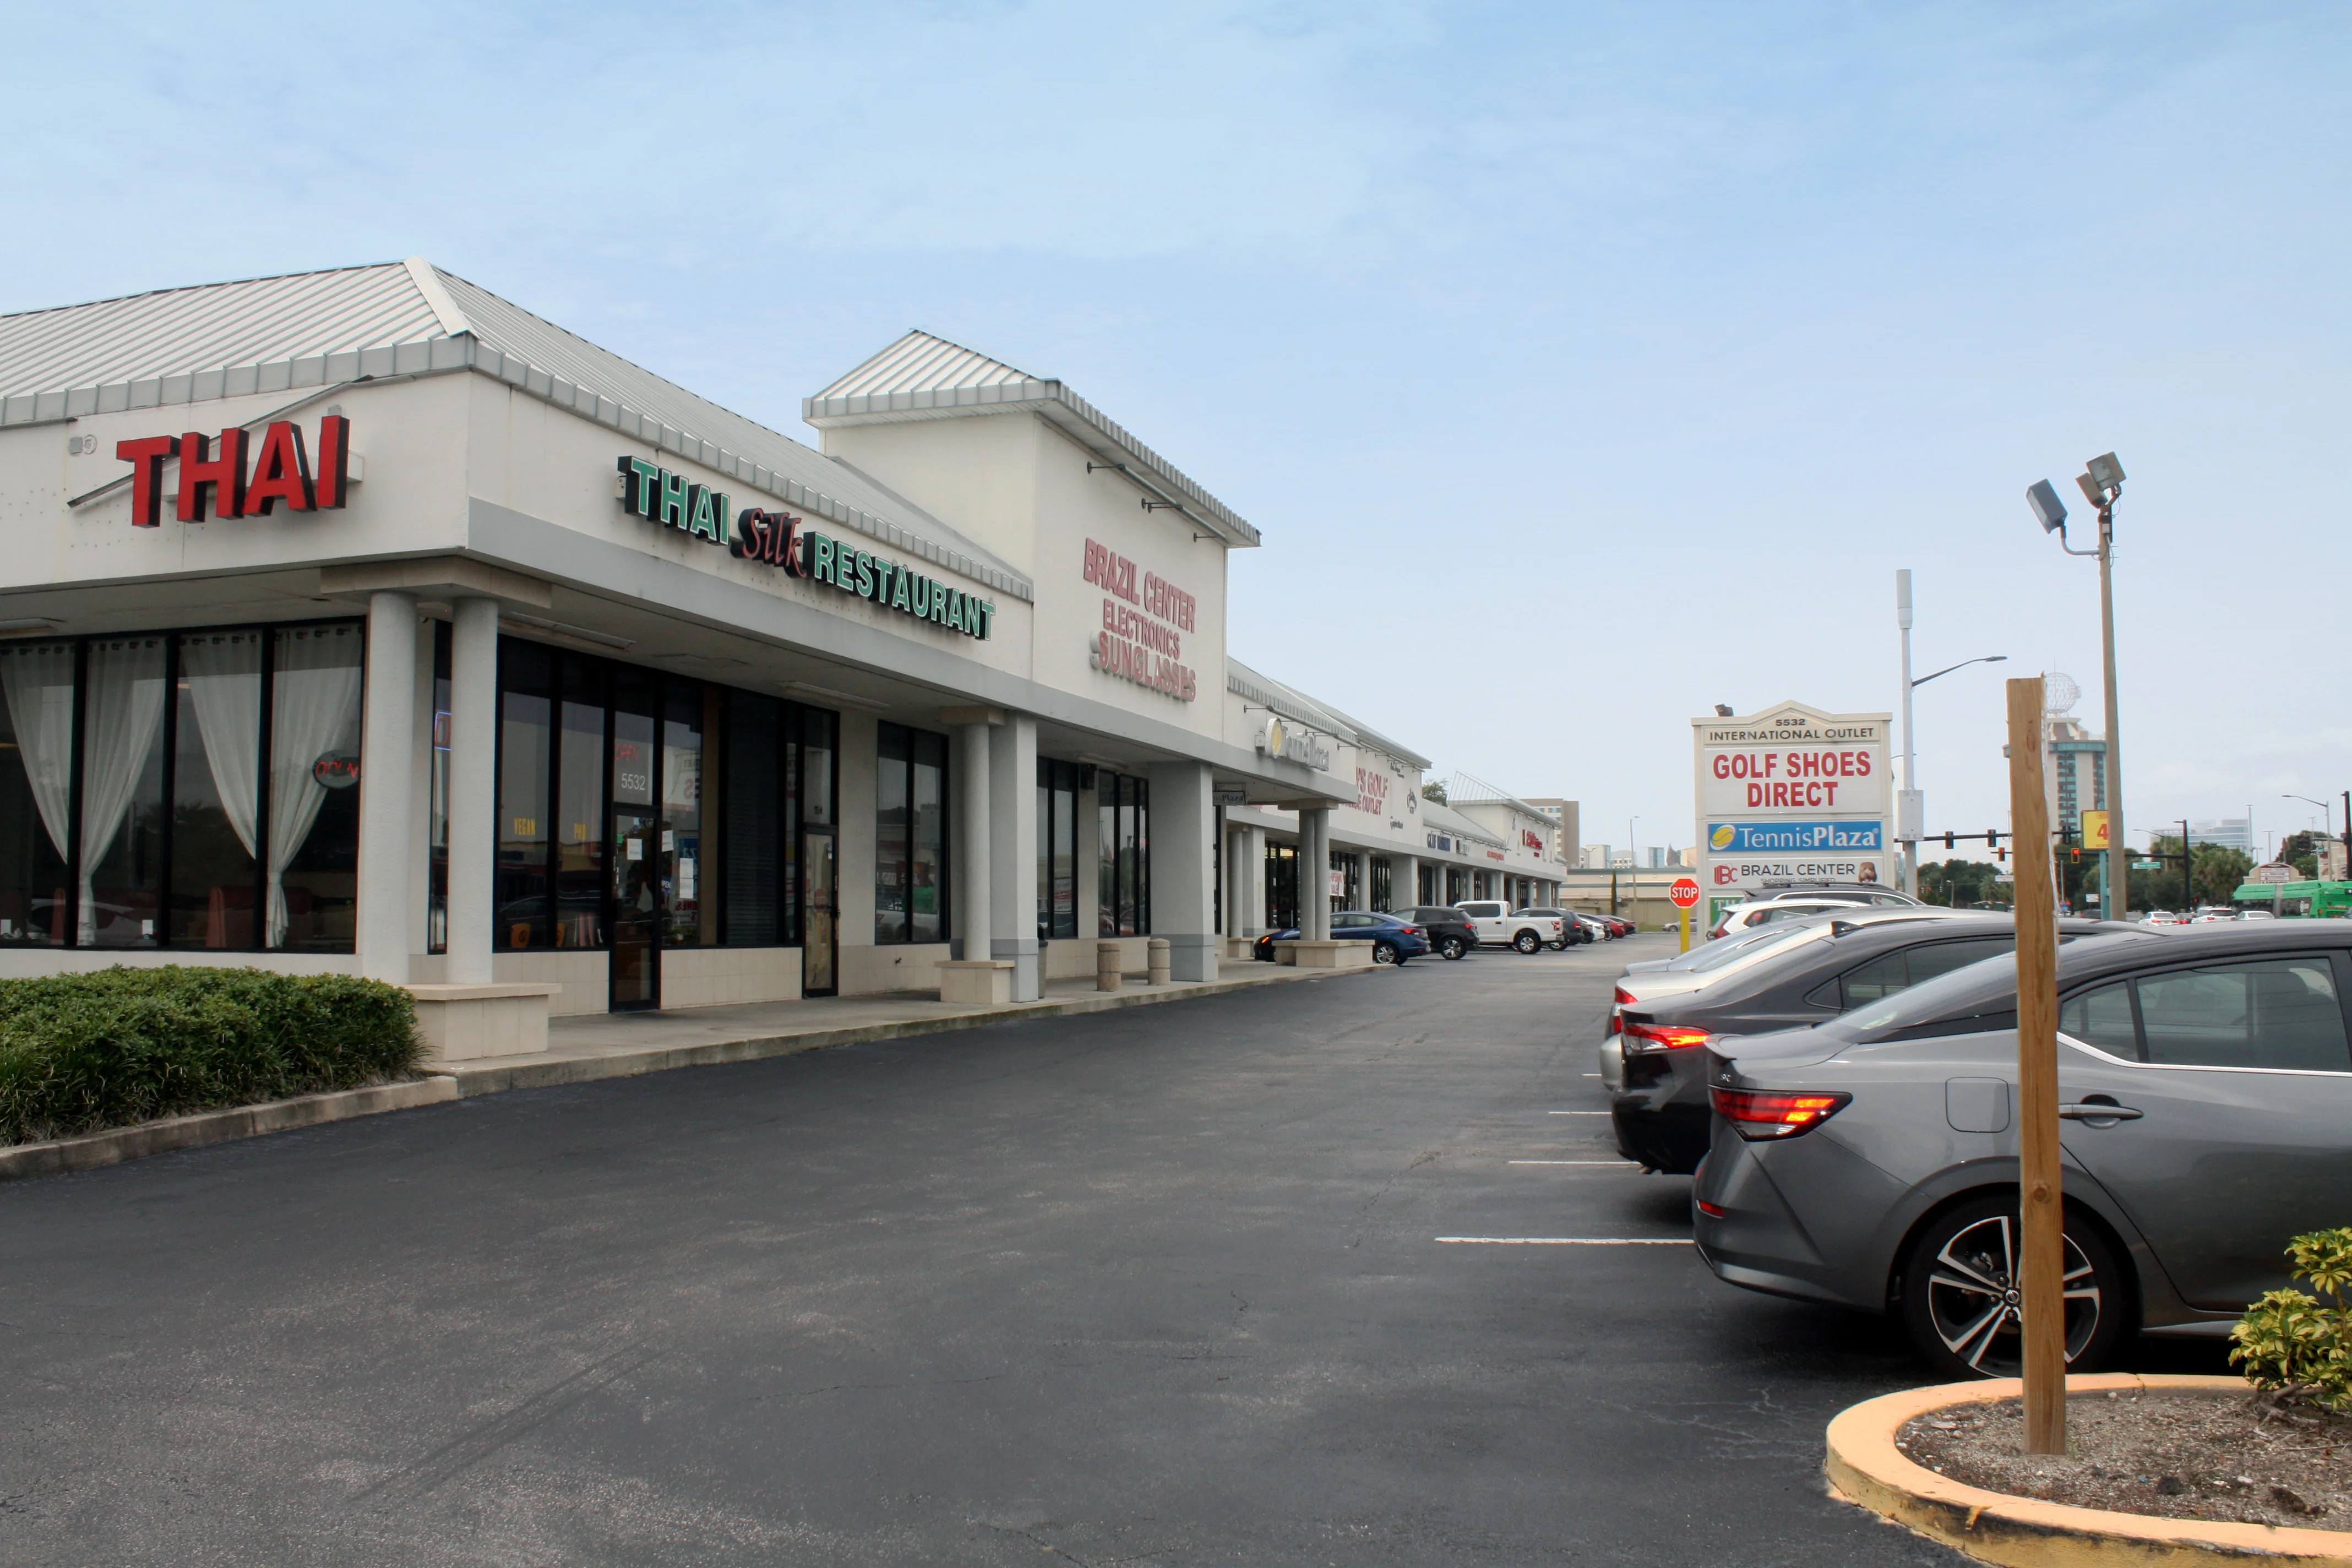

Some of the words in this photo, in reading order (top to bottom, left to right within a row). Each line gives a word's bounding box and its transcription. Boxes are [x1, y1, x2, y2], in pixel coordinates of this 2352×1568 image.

[116, 415, 350, 528] THAI
[627, 456, 730, 546] THAI
[741, 508, 807, 578] Silk
[812, 531, 996, 641] RESTAURANT
[1084, 537, 1140, 605] BRAZIL
[1144, 571, 1196, 633] CENTER
[1103, 598, 1180, 660] ELECTRONICS
[1096, 631, 1196, 702] SUNGLASSES
[1710, 729, 1820, 741] INTERNATIONAL
[1825, 728, 1874, 738] OUTLET
[1713, 753, 1777, 780] GOLF
[1787, 751, 1871, 777] SHOES
[621, 773, 645, 790] 5532
[1368, 771, 1388, 798] GOLF
[1363, 795, 1382, 815] OUTLET
[1747, 781, 1838, 807] DIRECT
[514, 818, 536, 835] VEGAN
[574, 824, 586, 840] PHO
[1739, 825, 1876, 848] TennisPlaza
[2097, 823, 2108, 840] 4
[1741, 864, 1795, 876] BRAZIL
[1796, 864, 1855, 875] CENTER
[1672, 887, 1698, 899] STOP
